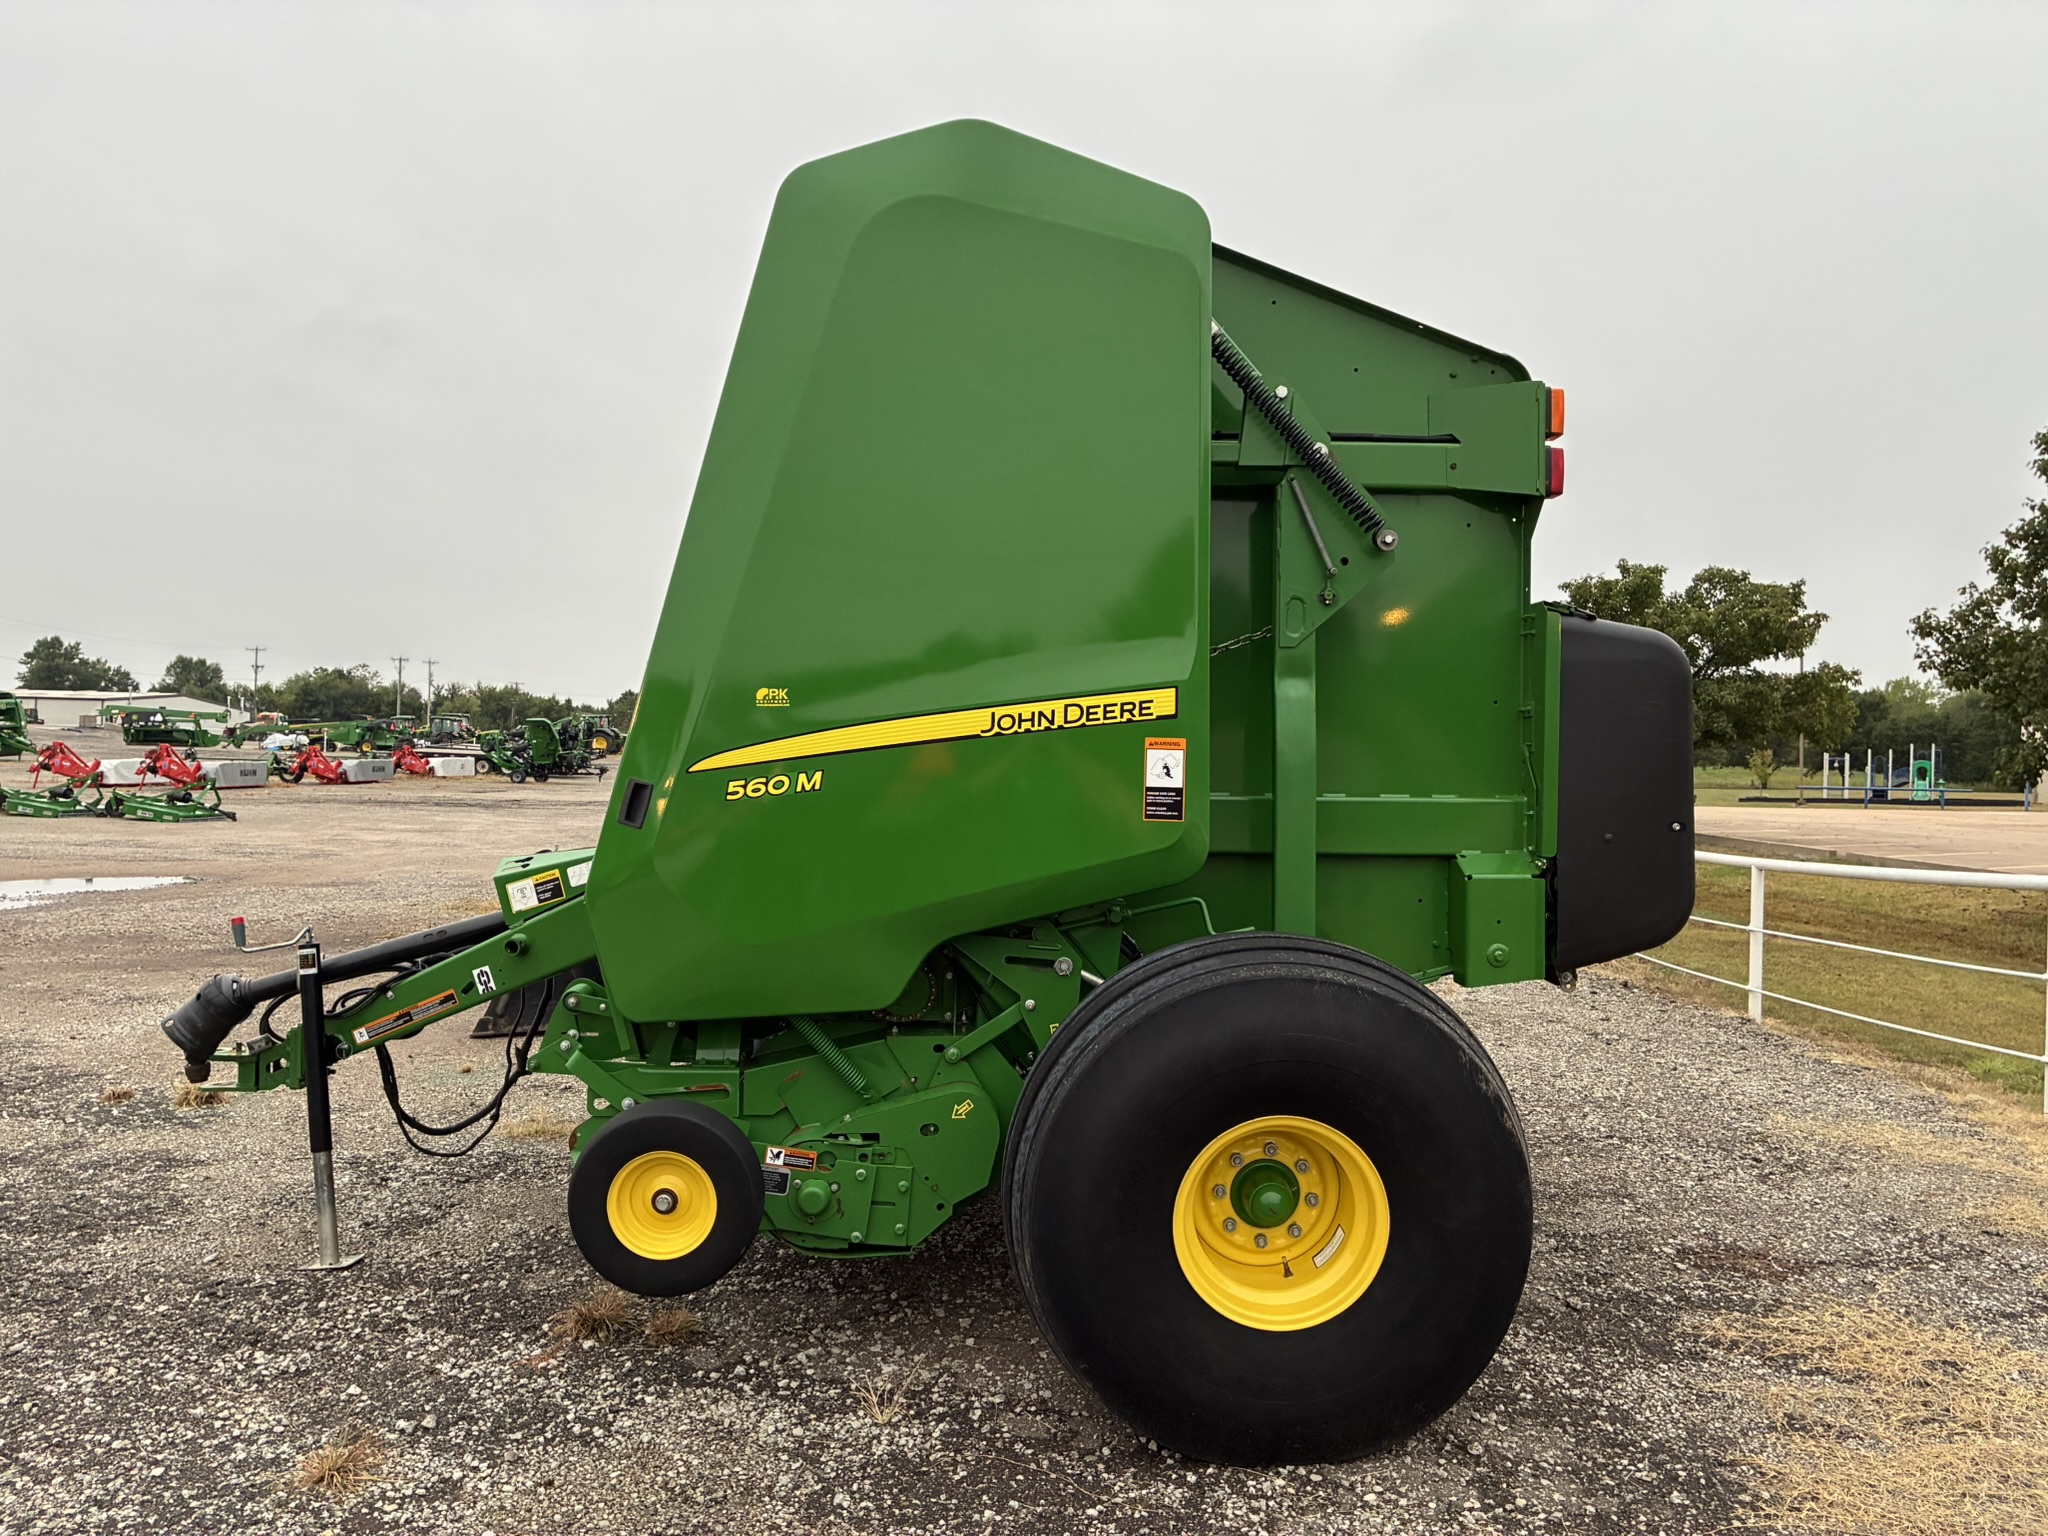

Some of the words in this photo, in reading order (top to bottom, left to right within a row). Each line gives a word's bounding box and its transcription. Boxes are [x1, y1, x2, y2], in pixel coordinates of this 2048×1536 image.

[980, 709, 1056, 734] JOHN
[1063, 699, 1154, 724] DEERE
[725, 773, 791, 801] 560
[795, 769, 824, 794] M
